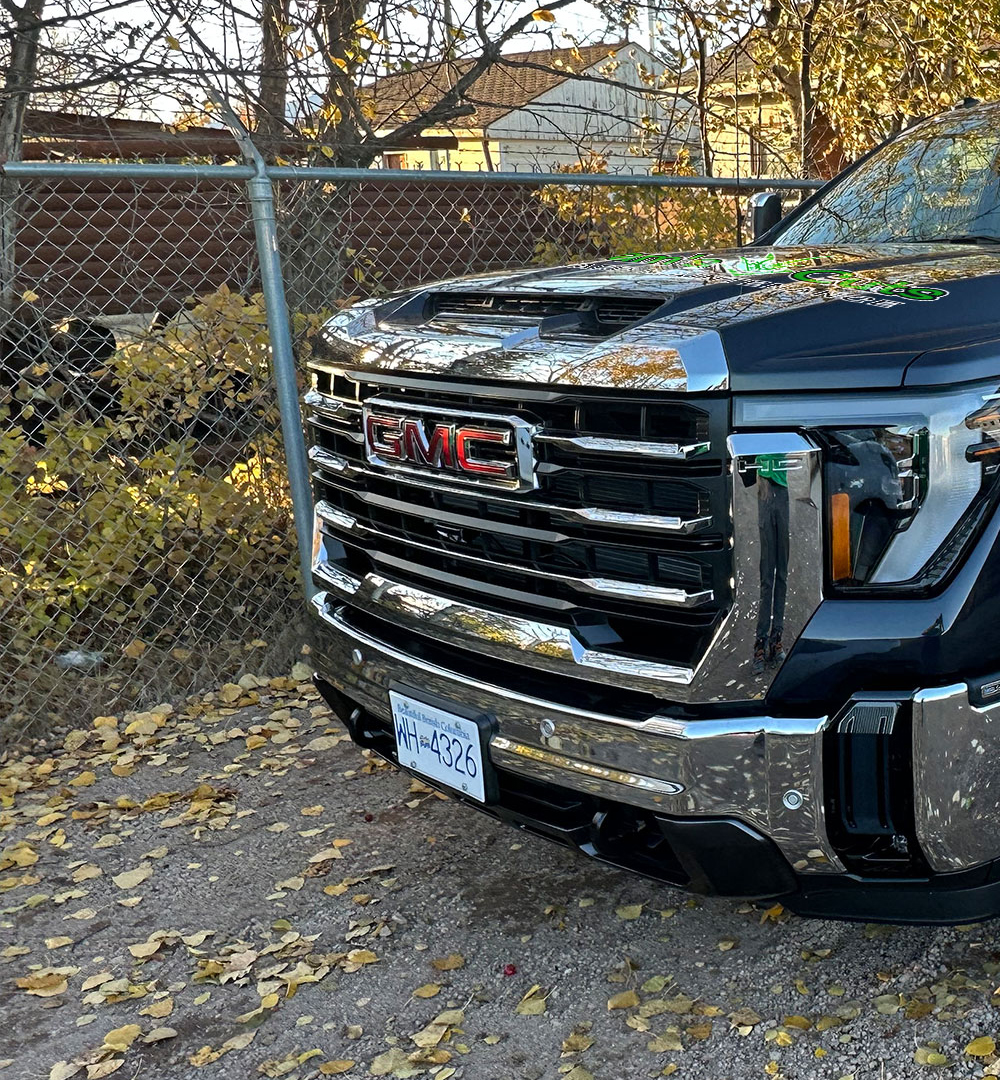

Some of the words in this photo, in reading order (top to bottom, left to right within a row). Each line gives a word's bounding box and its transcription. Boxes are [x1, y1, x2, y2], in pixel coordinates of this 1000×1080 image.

[367, 415, 516, 477] GMC
[394, 713, 420, 754] WH
[430, 729, 478, 778] 4326
